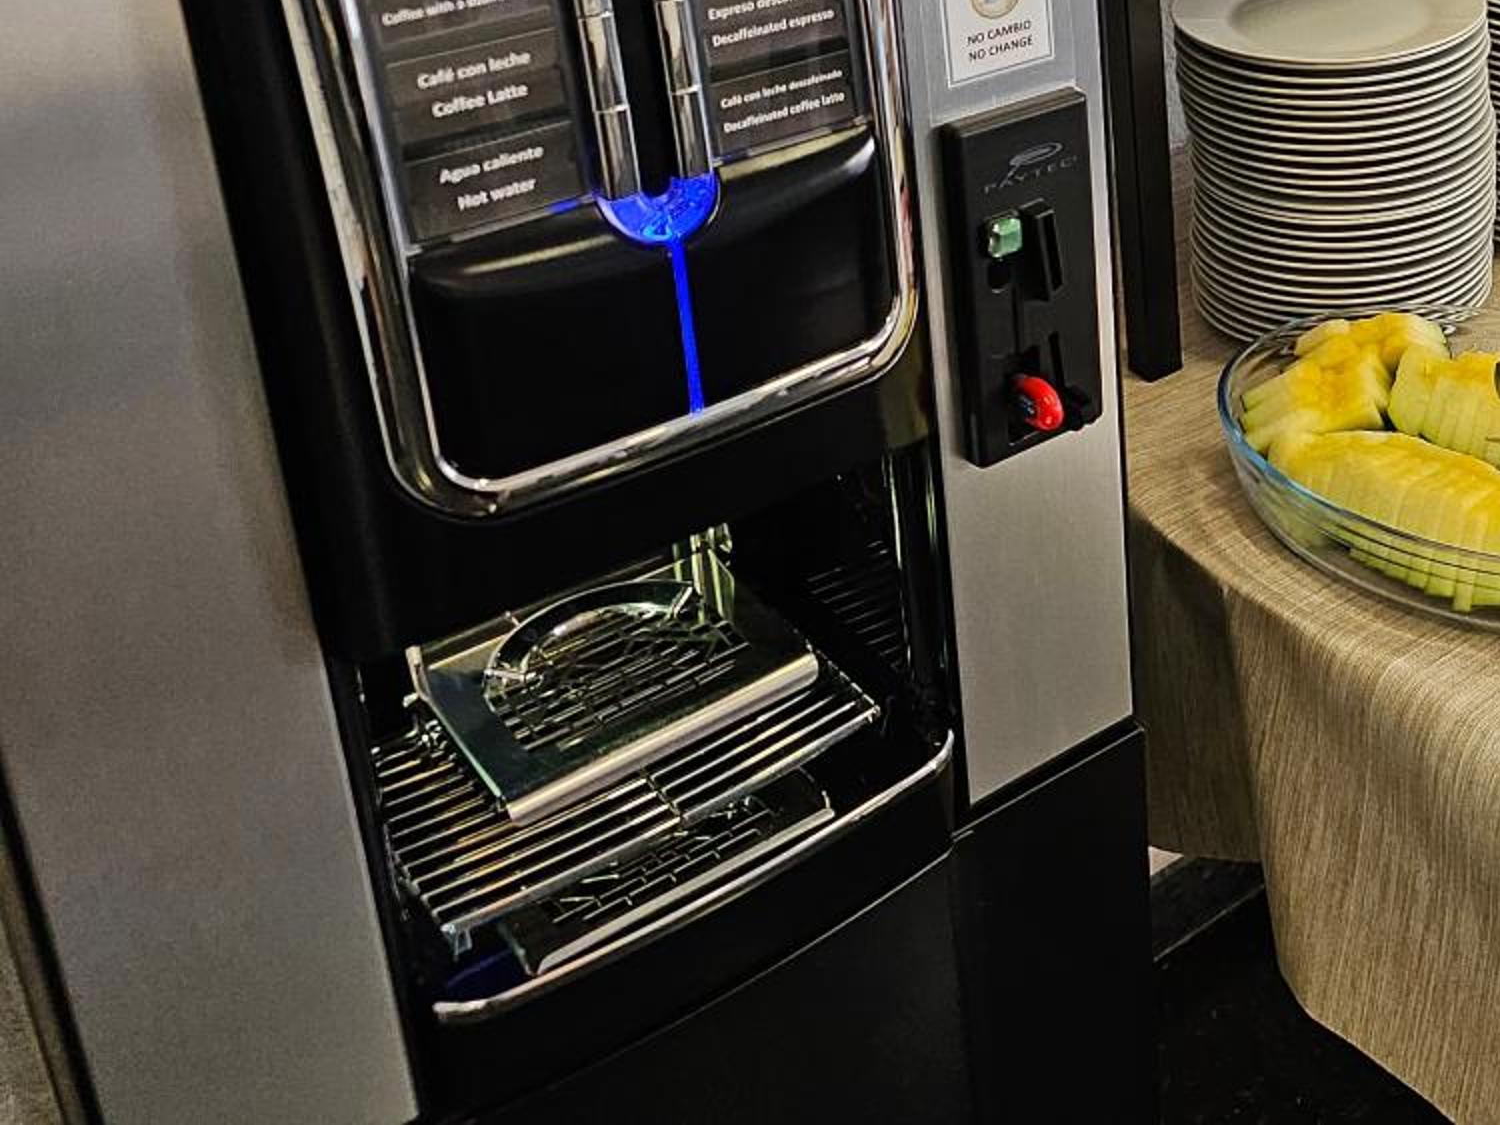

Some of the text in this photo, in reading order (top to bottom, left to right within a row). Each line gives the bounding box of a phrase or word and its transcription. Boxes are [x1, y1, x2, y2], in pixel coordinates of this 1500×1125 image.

[707, 1, 755, 21] Expreso
[711, 8, 835, 48] Decaffeinated espresso
[967, 20, 1032, 47] NO CAMBIO
[968, 34, 1034, 64] NO CHANGE
[417, 51, 532, 89] Café con leche
[431, 84, 529, 119] Coffee Latte
[762, 81, 787, 100] leche
[789, 98, 821, 118] coffee
[440, 146, 545, 185] Agua caliente
[457, 178, 537, 212] Hot water
